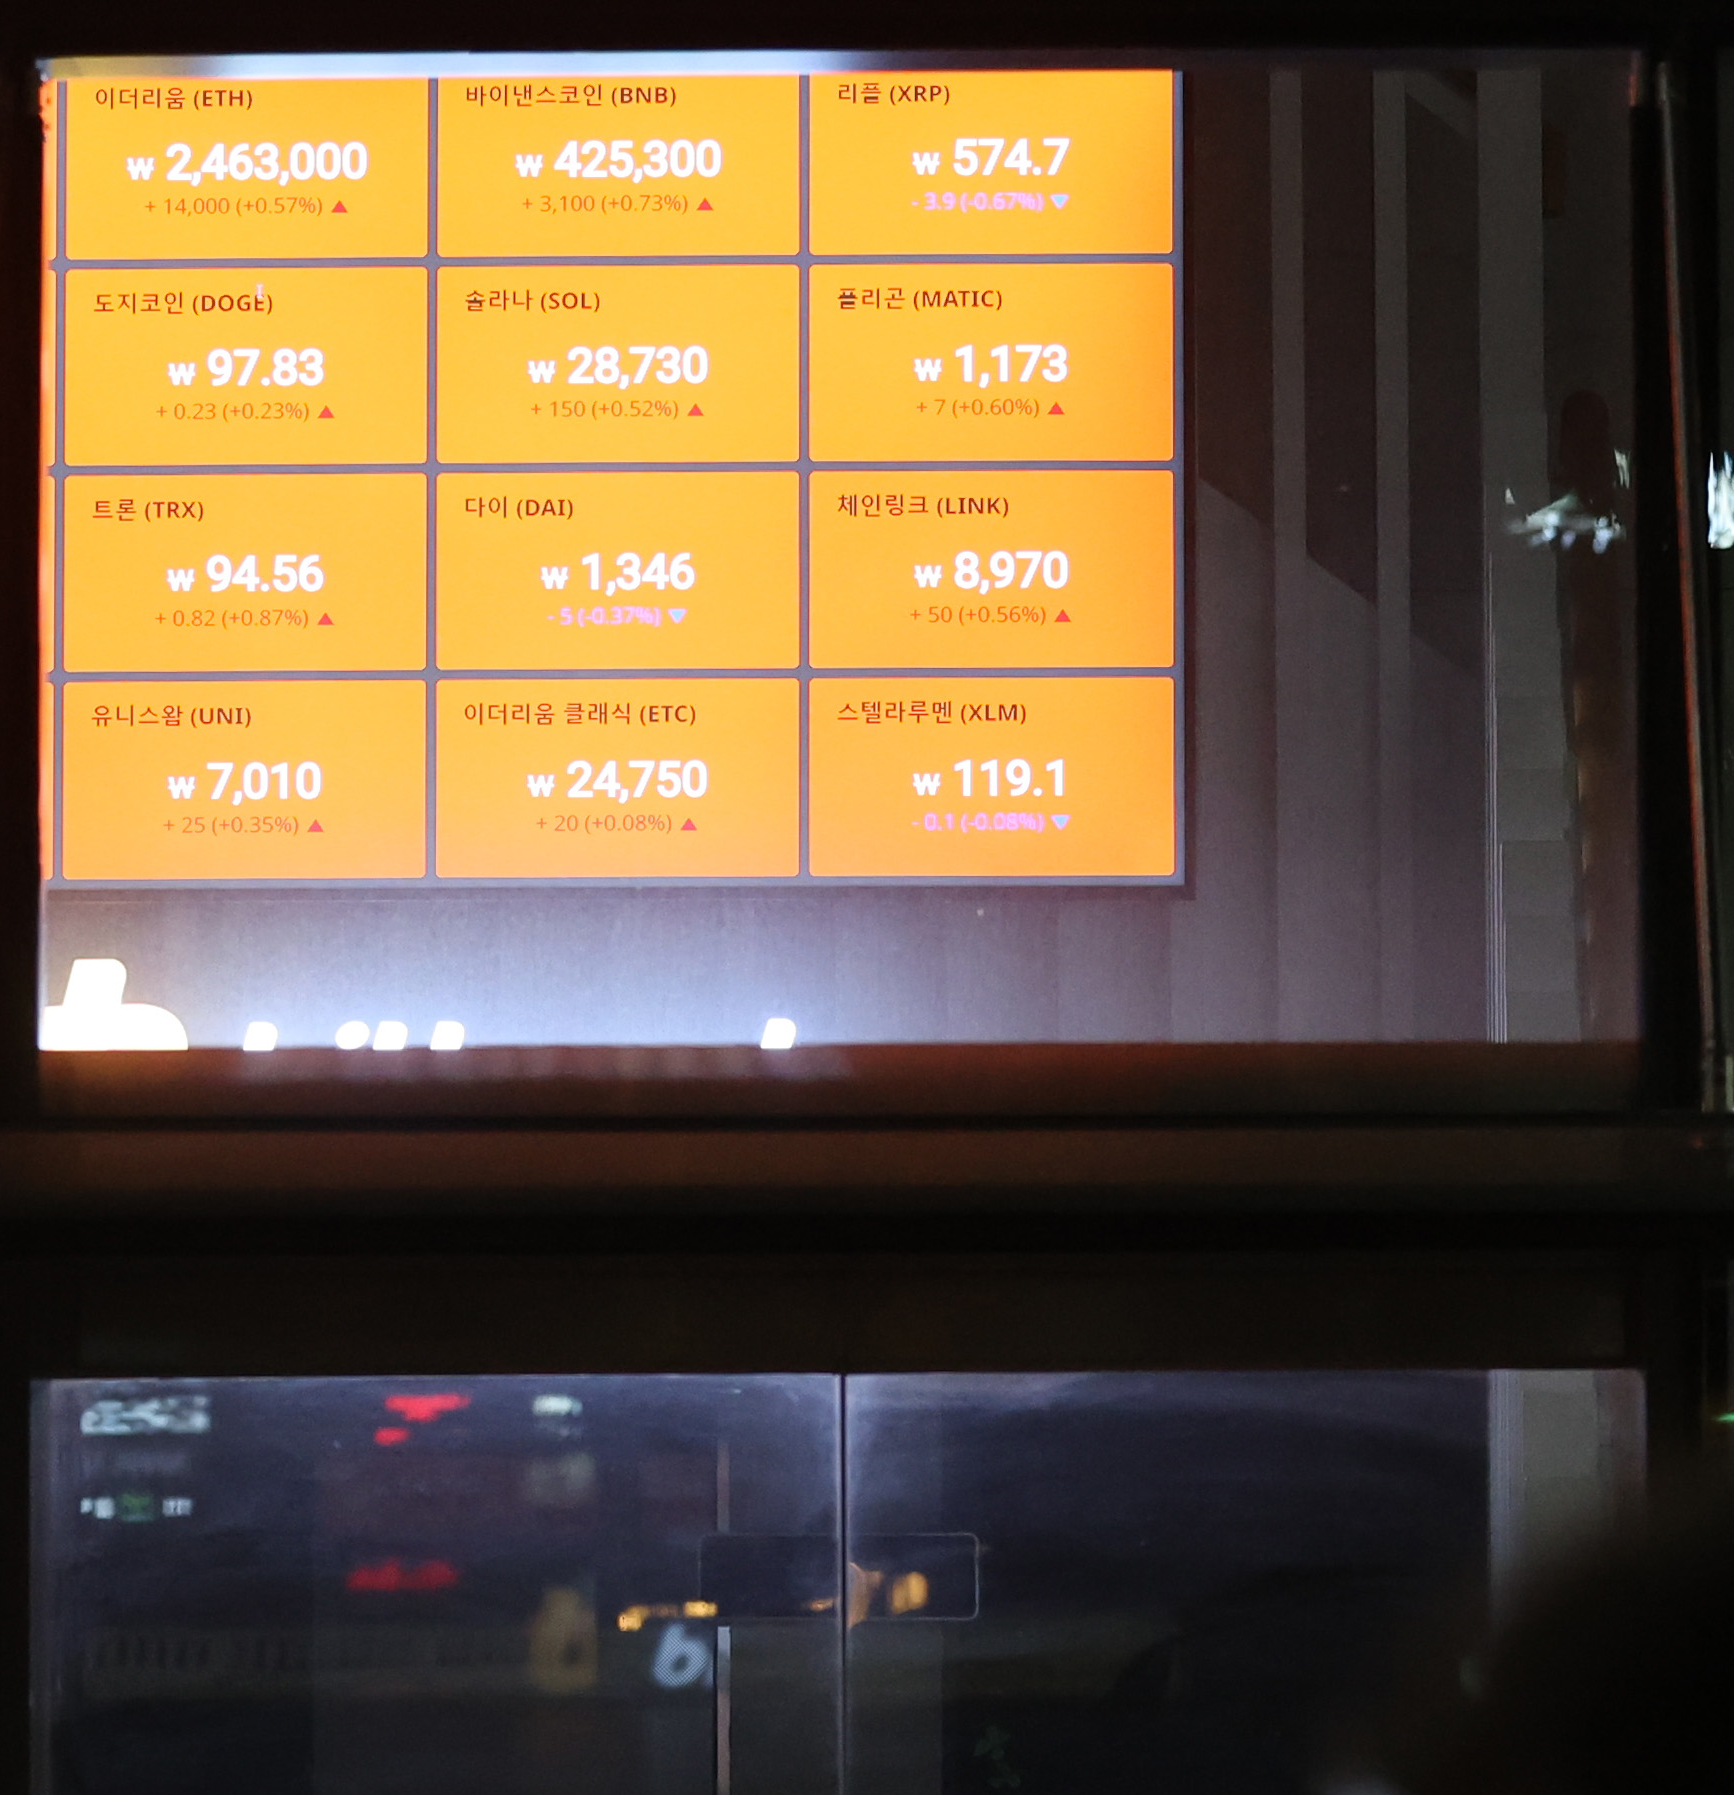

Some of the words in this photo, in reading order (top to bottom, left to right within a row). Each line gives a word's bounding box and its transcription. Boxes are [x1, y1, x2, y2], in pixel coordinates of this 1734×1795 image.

[95, 87, 186, 110] 이더리움
[193, 89, 253, 111] (ETH)
[466, 83, 602, 108] 바이낸스코인
[611, 86, 677, 108] (BNB)
[838, 82, 882, 105] 리플
[889, 84, 951, 106] (XRP)
[166, 141, 369, 186] 2,463,000
[553, 139, 723, 183] 425,300
[953, 137, 1071, 176] 574.7
[164, 197, 231, 217] 14,000
[235, 196, 323, 217] (+0.57%)
[539, 194, 595, 215] 3,100
[601, 193, 689, 216] (+0.73%)
[93, 291, 184, 315] 도지코인
[192, 295, 273, 317] (DOGE)
[465, 288, 533, 312] 솔라나
[540, 291, 600, 314] (SOL)
[837, 287, 906, 310] 폴리곤
[913, 289, 1003, 312] (MATIC)
[207, 347, 325, 386] 97.83
[567, 345, 709, 389] 28,730
[955, 344, 1068, 388] 1,173
[173, 402, 217, 420] 0.23
[222, 401, 310, 424] (+0.23%)
[550, 400, 586, 418] 150
[591, 399, 679, 421] (+0.52%)
[934, 398, 947, 416] 7
[952, 398, 1040, 420] (+0.60%)
[92, 498, 137, 522] 트론
[144, 501, 204, 523] (TRX)
[465, 495, 507, 520] 다이
[516, 498, 574, 521] (DAI)
[837, 493, 929, 518] 체인링크
[936, 496, 1009, 519] (LINK)
[206, 554, 325, 592] 94.56
[581, 552, 696, 596] 1,346
[954, 550, 1069, 595] 8,970
[172, 609, 217, 628] 0.82
[221, 609, 309, 631] (+0.87%)
[928, 605, 953, 624] 50
[958, 605, 1047, 627] (+0.56%)
[190, 707, 252, 729] (UNI)
[464, 702, 556, 726] 이더리움
[563, 701, 631, 725] 클래식
[639, 704, 696, 727] (ETC)
[837, 700, 952, 725] 스텔라루멘
[960, 703, 1027, 726] (XLM)
[206, 761, 323, 805] 7,010
[567, 759, 709, 804] 24,750
[953, 758, 1064, 796] 119.1
[181, 816, 206, 834] 25
[211, 815, 299, 837] (+0.35%)
[554, 814, 579, 832] 20
[584, 813, 672, 835] (+0.08%)
